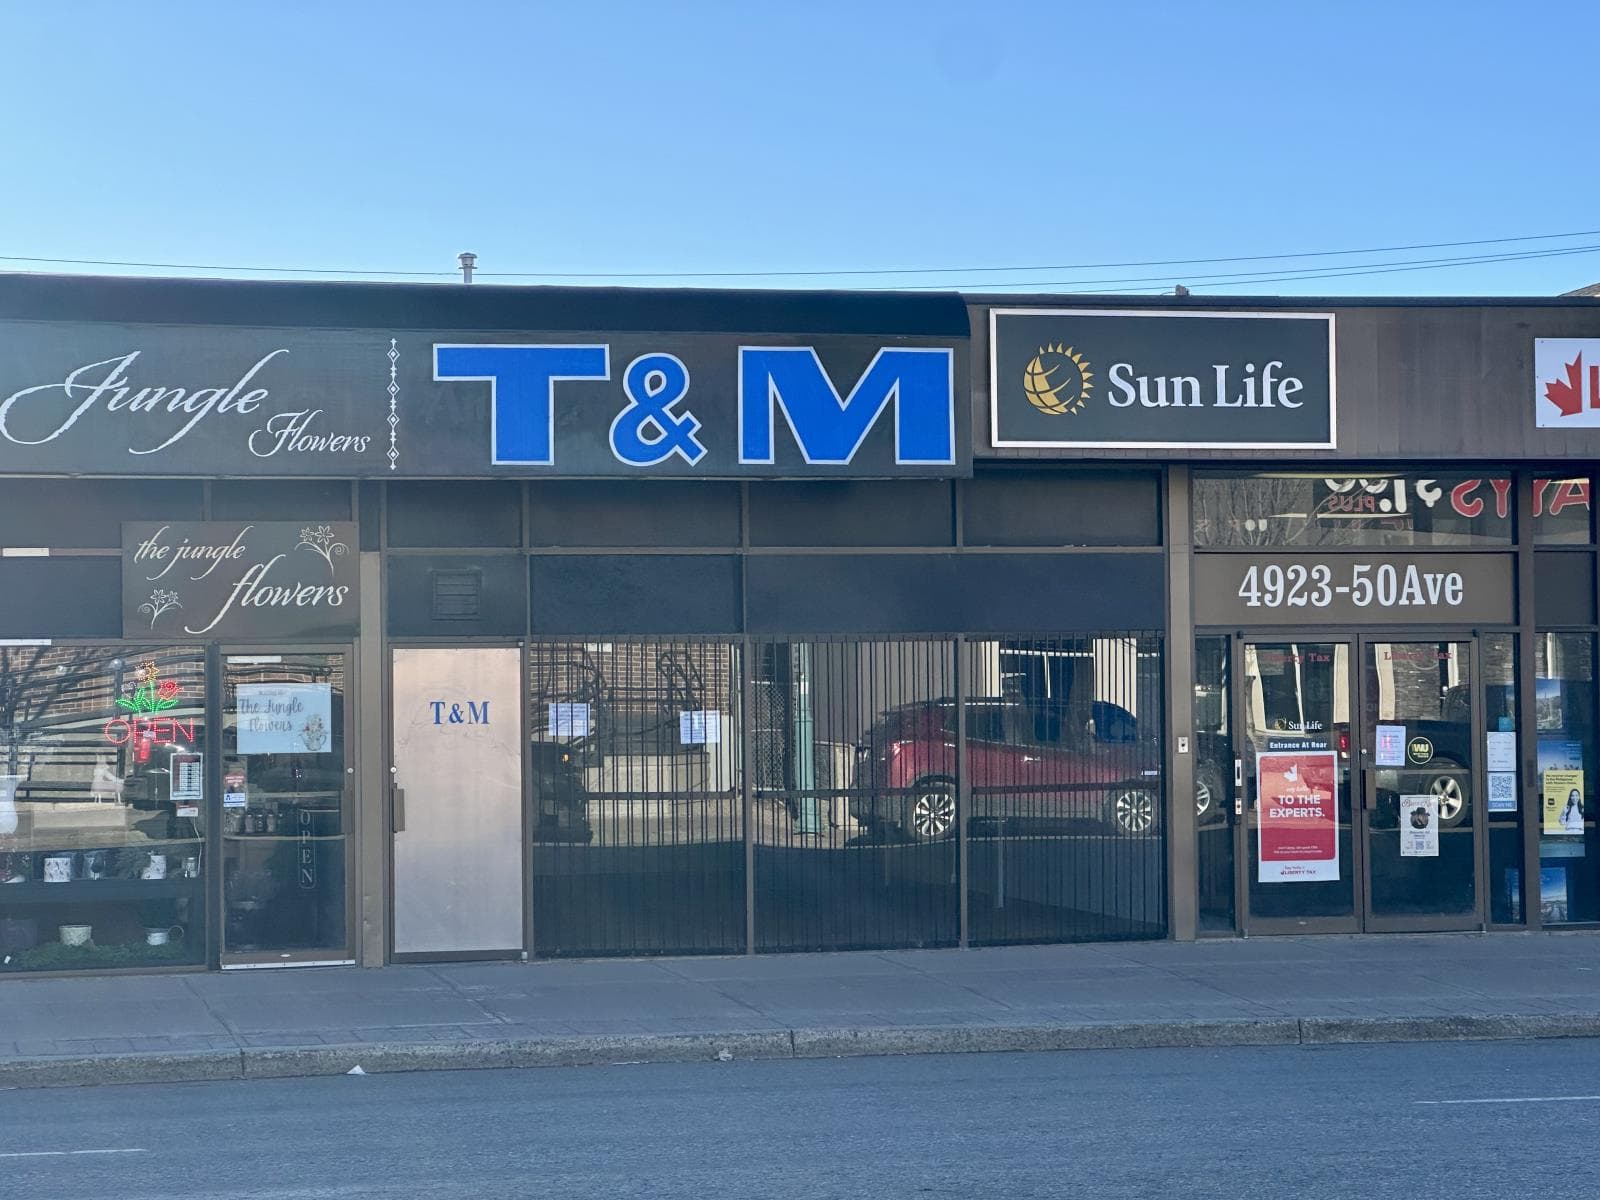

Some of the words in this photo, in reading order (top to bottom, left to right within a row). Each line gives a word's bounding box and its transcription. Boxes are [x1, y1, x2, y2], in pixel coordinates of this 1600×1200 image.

[1108, 363, 1204, 408] Sun
[1212, 361, 1304, 409] Life
[0, 349, 289, 455] Jungle
[433, 344, 955, 467] T&M
[248, 409, 371, 458] Flowers
[134, 525, 170, 563] the
[146, 525, 255, 581] jungle
[184, 554, 349, 634] flowers
[1309, 653, 1331, 662] Tax
[239, 698, 260, 714] The
[263, 696, 304, 717] Jungle
[430, 701, 490, 725] T&M
[104, 717, 194, 744] OPEN
[1306, 720, 1323, 730] Life
[1269, 741, 1300, 749] Entrance
[1301, 741, 1310, 749] At
[1311, 741, 1328, 749] Rear
[1269, 808, 1326, 818] EXPERTS.
[1278, 794, 1294, 804] TO
[1297, 794, 1321, 804] THE
[300, 810, 314, 884] OPEN
